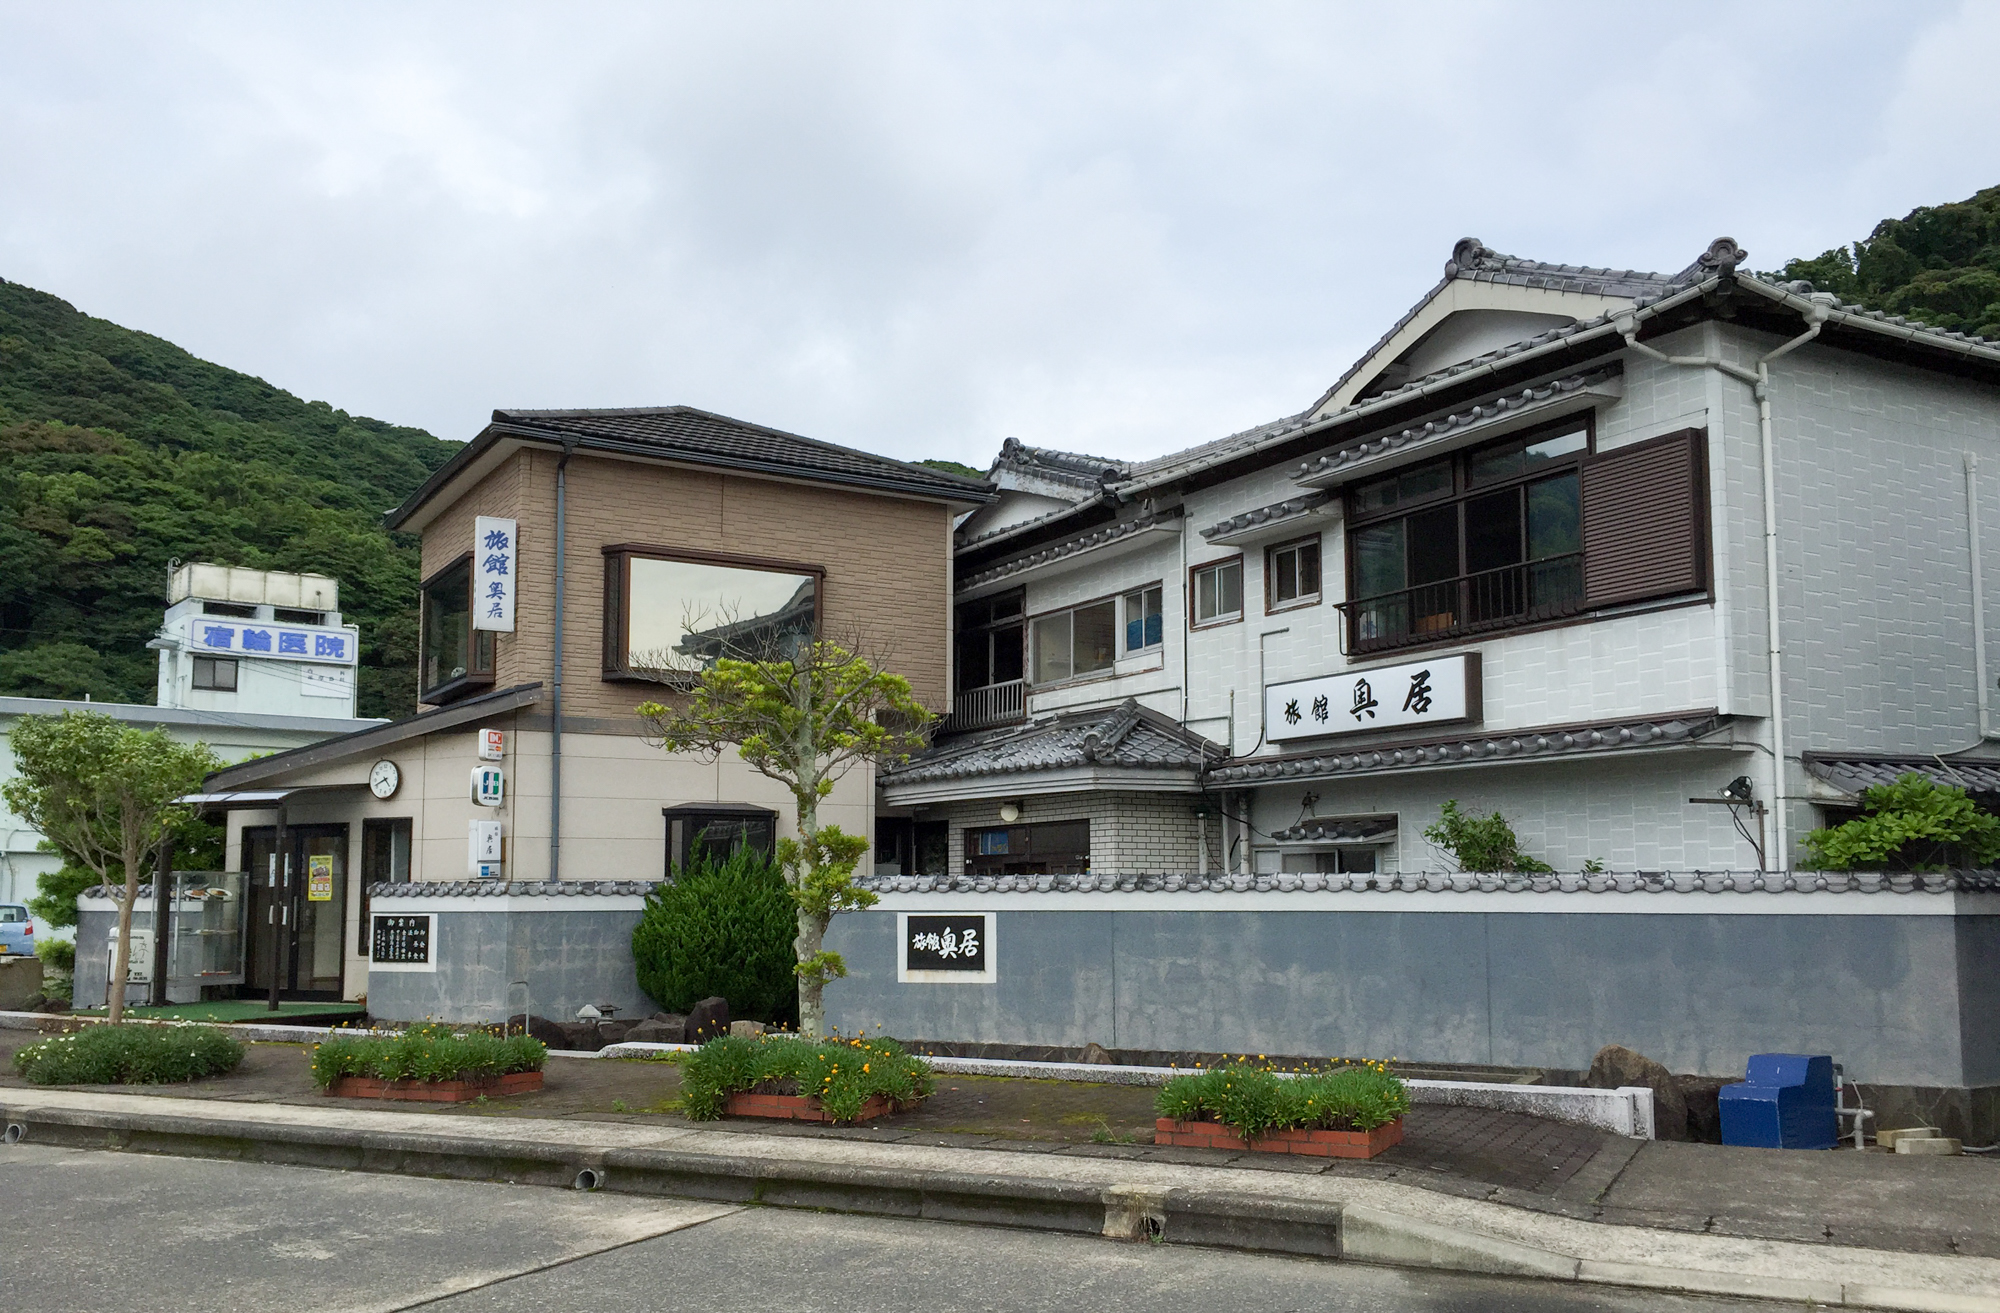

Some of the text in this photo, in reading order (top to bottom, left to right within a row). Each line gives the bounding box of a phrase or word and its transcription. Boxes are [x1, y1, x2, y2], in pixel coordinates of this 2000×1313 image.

[203, 625, 345, 659] 宿輪医院
[489, 732, 502, 744] DC
